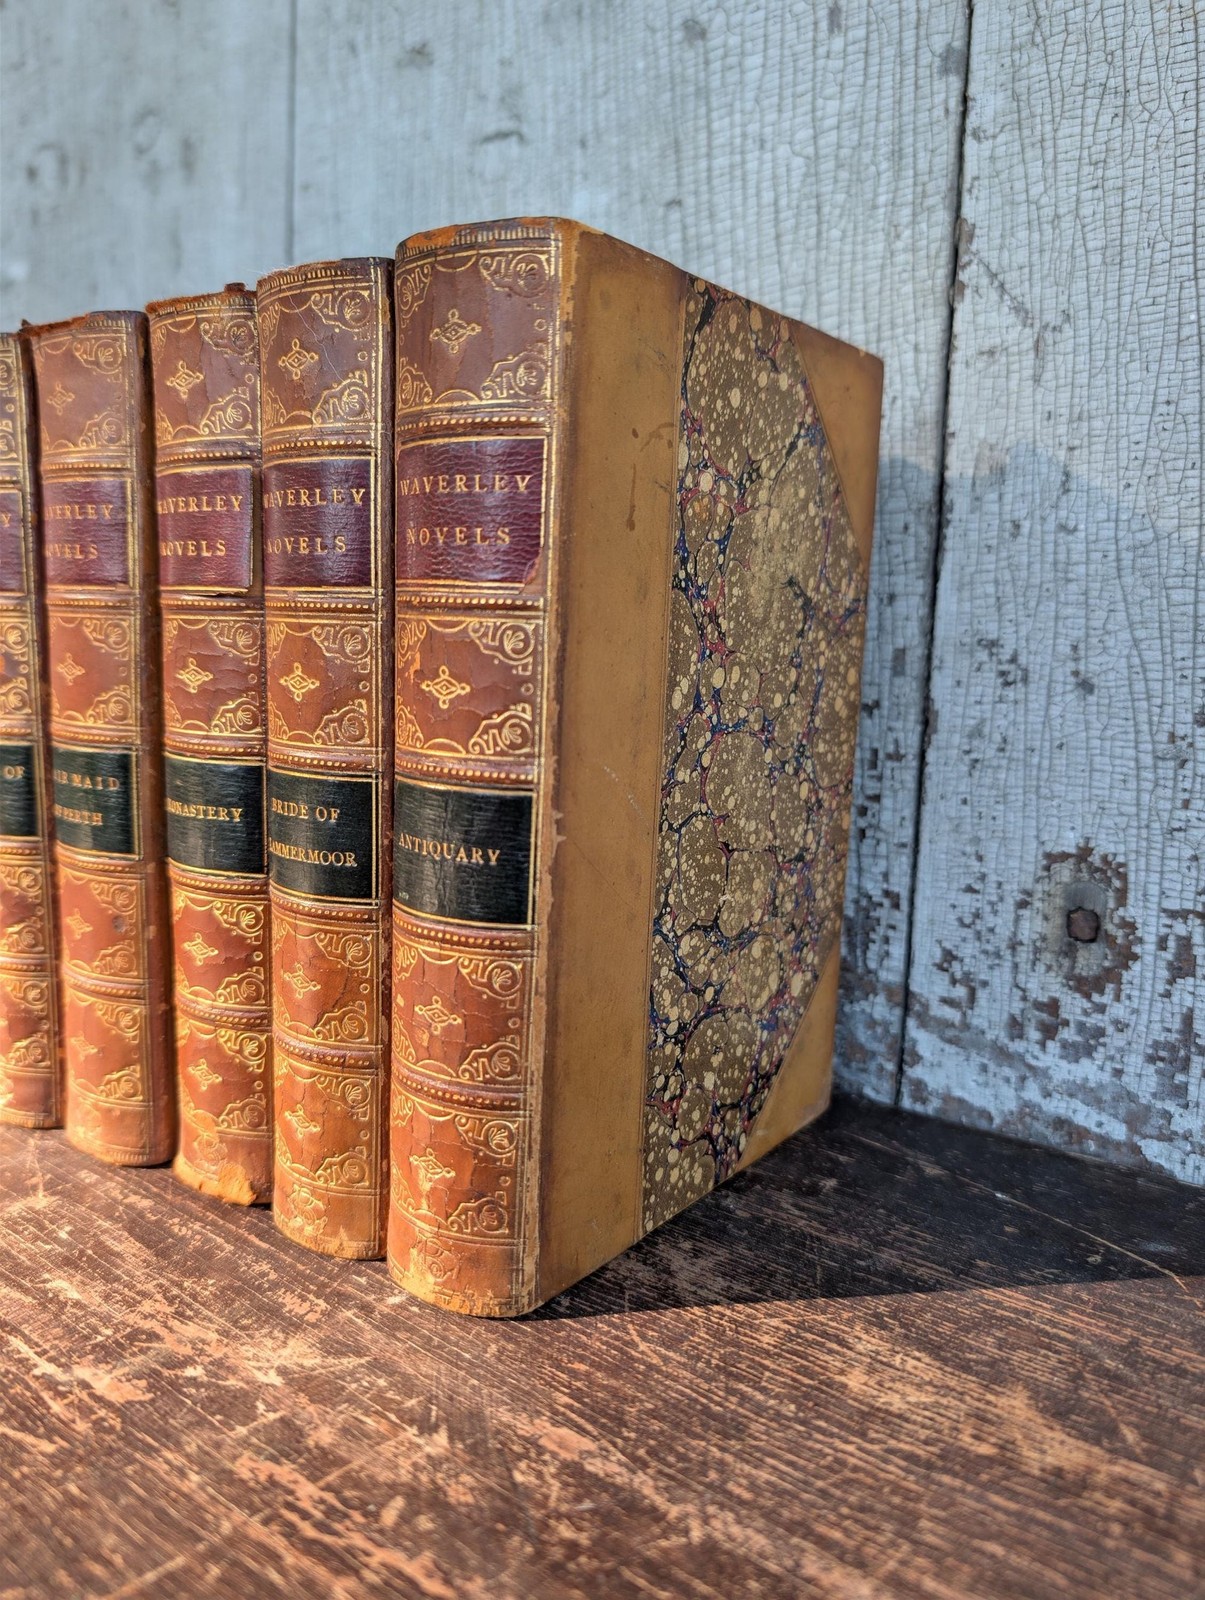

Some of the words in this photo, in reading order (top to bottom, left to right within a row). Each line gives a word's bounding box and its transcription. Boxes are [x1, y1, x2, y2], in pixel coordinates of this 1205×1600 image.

[400, 474, 532, 496] WAVERLEY
[406, 527, 510, 546] NOVELS
[71, 773, 120, 790] MAID
[271, 798, 309, 819] BRIDE
[315, 806, 340, 822] OF
[399, 833, 500, 865] ANTIQUARY
